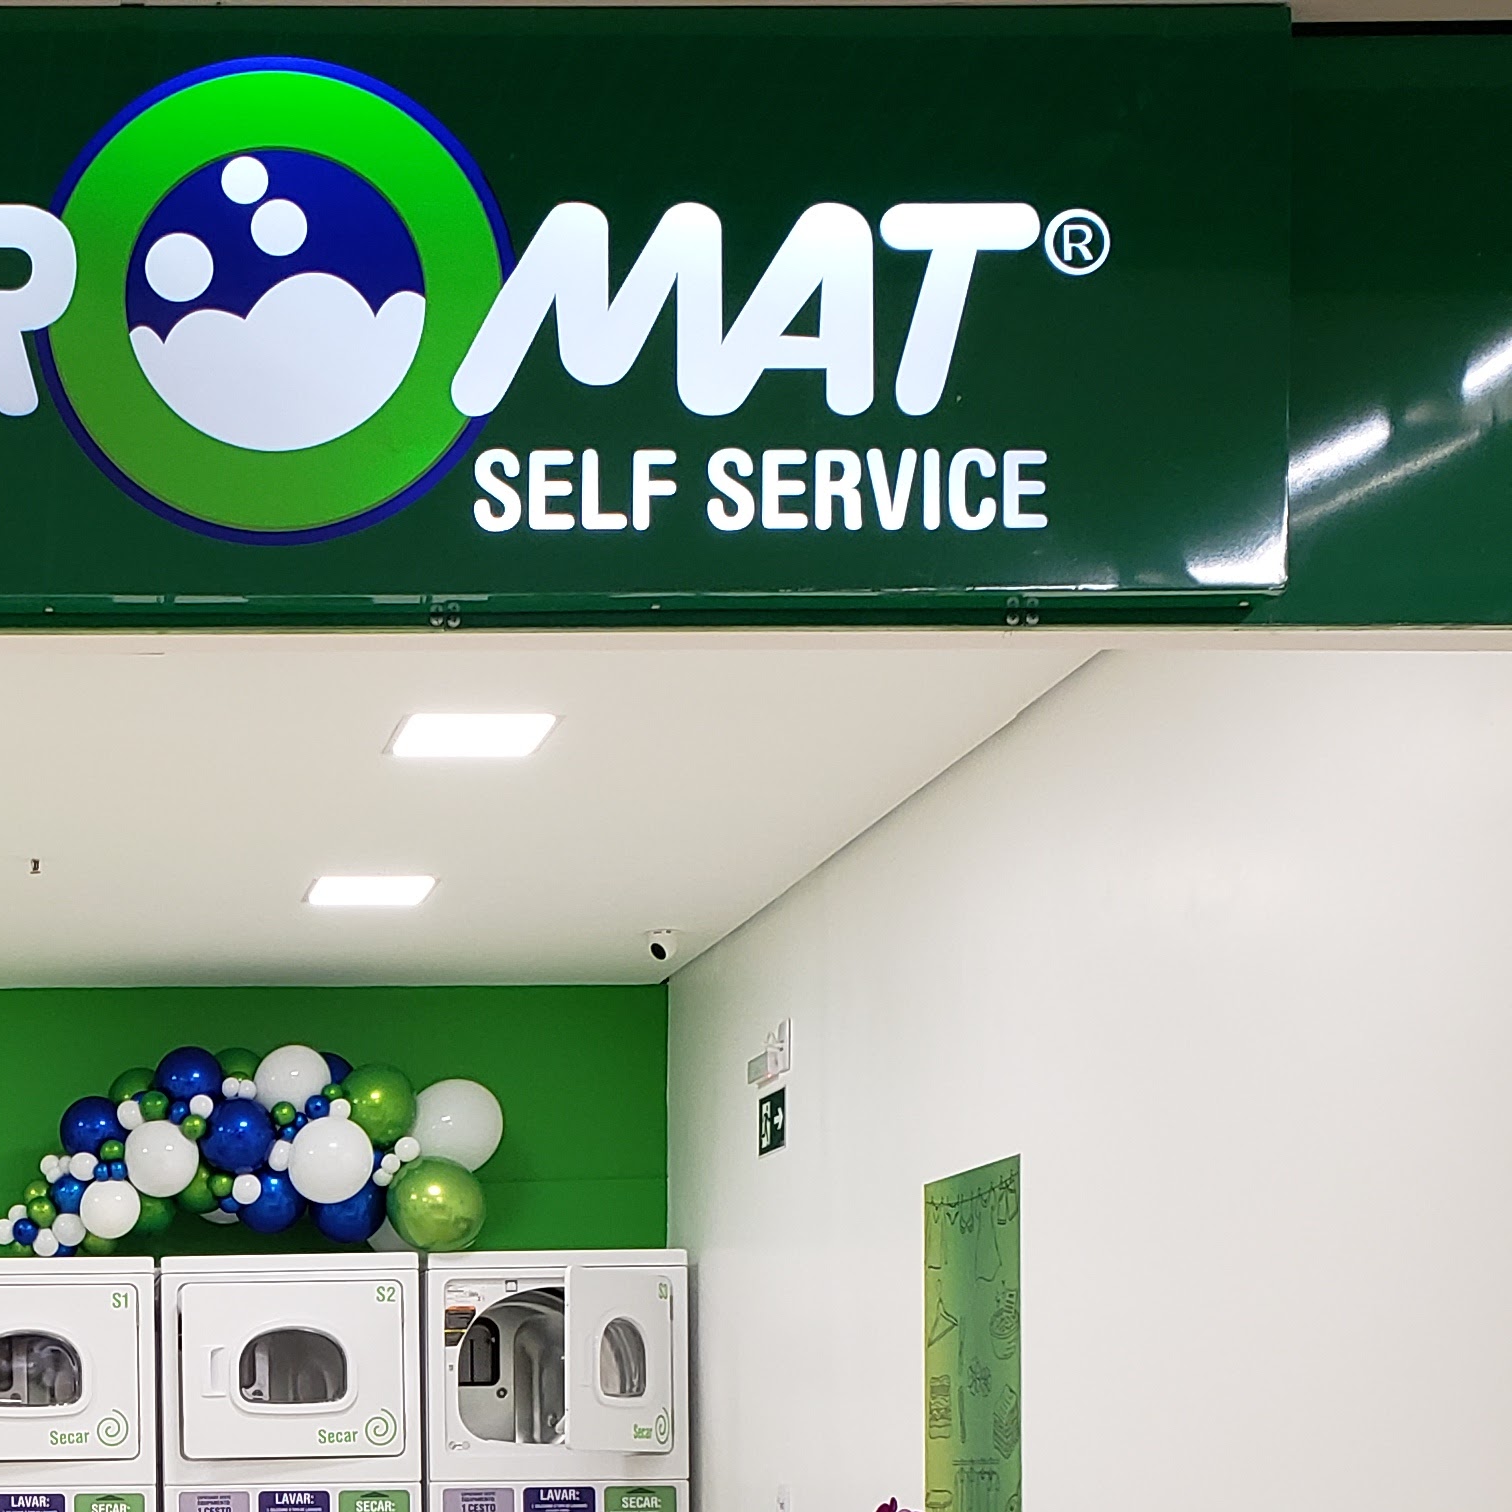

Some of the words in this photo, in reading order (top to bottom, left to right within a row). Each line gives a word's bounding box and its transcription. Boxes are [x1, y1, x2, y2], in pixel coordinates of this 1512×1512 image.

[473, 447, 677, 532] SELF
[706, 447, 1048, 532] SERVICE
[112, 1292, 129, 1309] S1
[376, 1286, 396, 1303] S2
[49, 1430, 90, 1446] Secar
[318, 1428, 359, 1444] Secar
[633, 1423, 653, 1440] Secar
[10, 1496, 51, 1508] LAVAR:
[275, 1492, 315, 1505] LAVAR:
[539, 1489, 580, 1501] LAVAR:
[355, 1500, 396, 1512] SECAR:
[468, 1503, 496, 1512] CESTO
[621, 1496, 662, 1509] SECAR:
